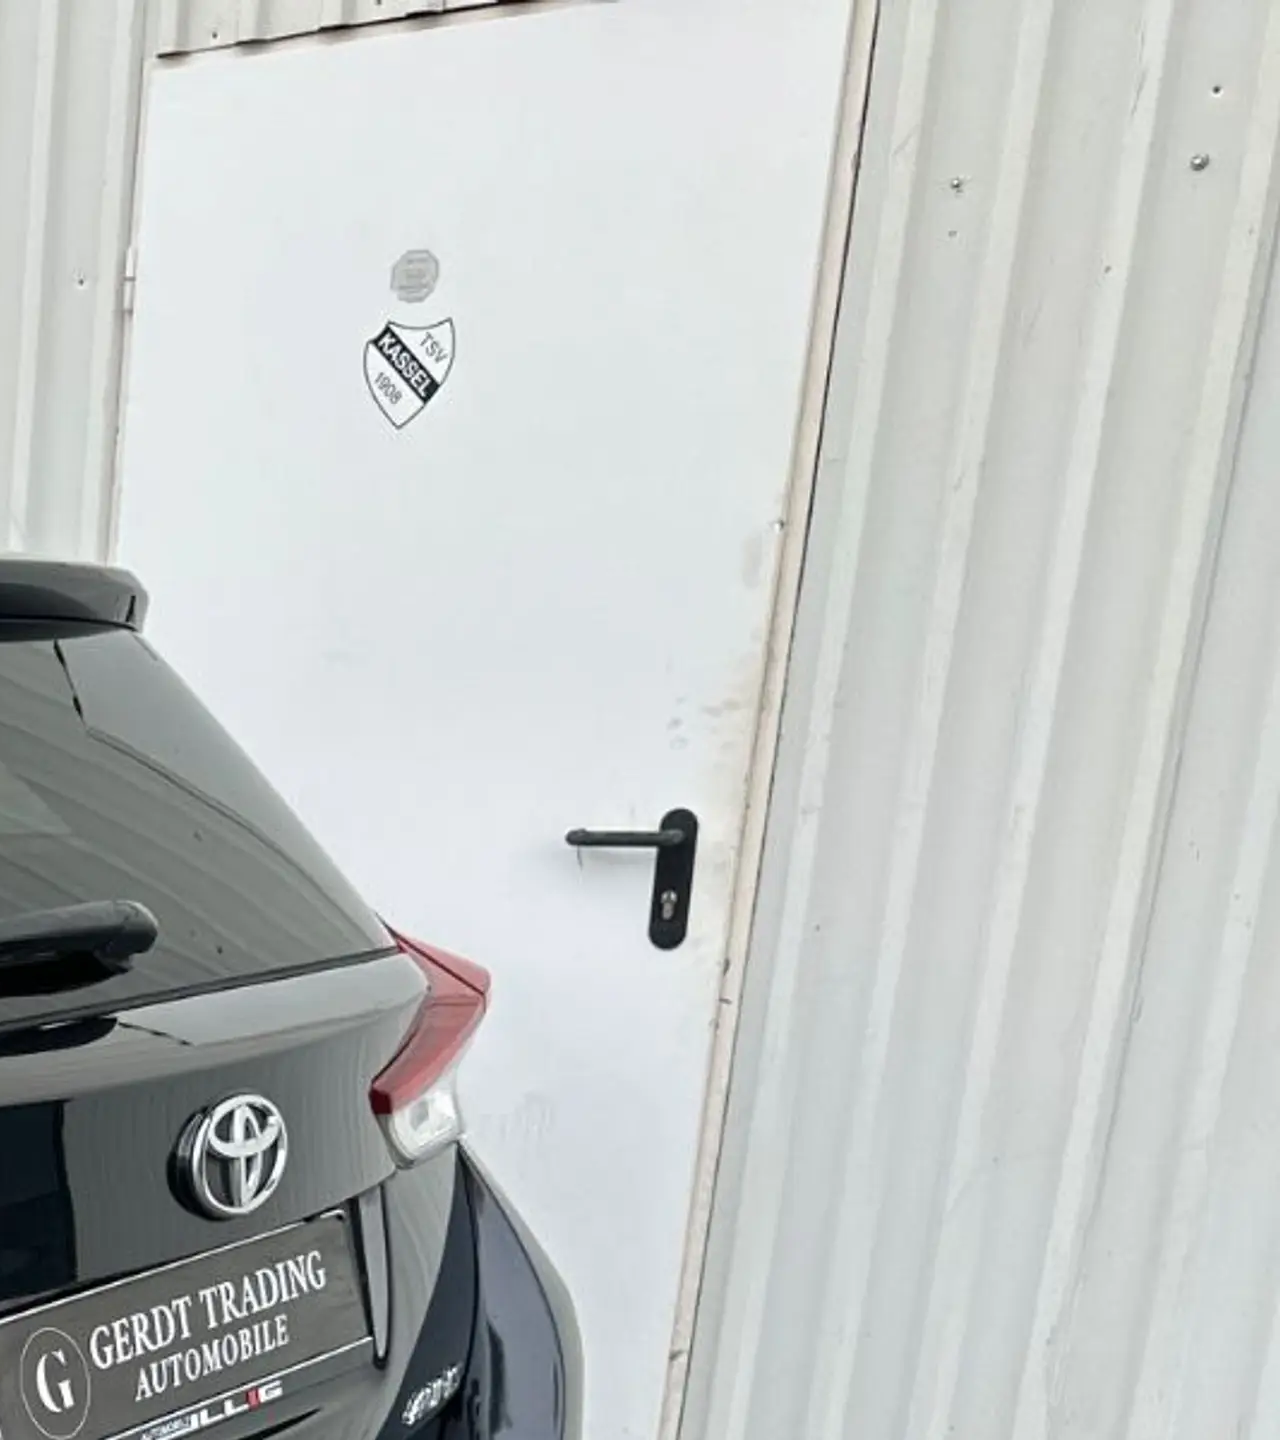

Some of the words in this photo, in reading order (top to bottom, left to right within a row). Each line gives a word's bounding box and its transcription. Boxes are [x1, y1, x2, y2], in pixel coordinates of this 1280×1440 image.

[378, 332, 431, 398] KASSEL
[420, 331, 449, 363] TSV
[89, 1295, 193, 1370] GERDT
[198, 1249, 327, 1330] TRADING
[36, 1346, 75, 1413] G
[134, 1312, 290, 1402] AUTOMOBILE
